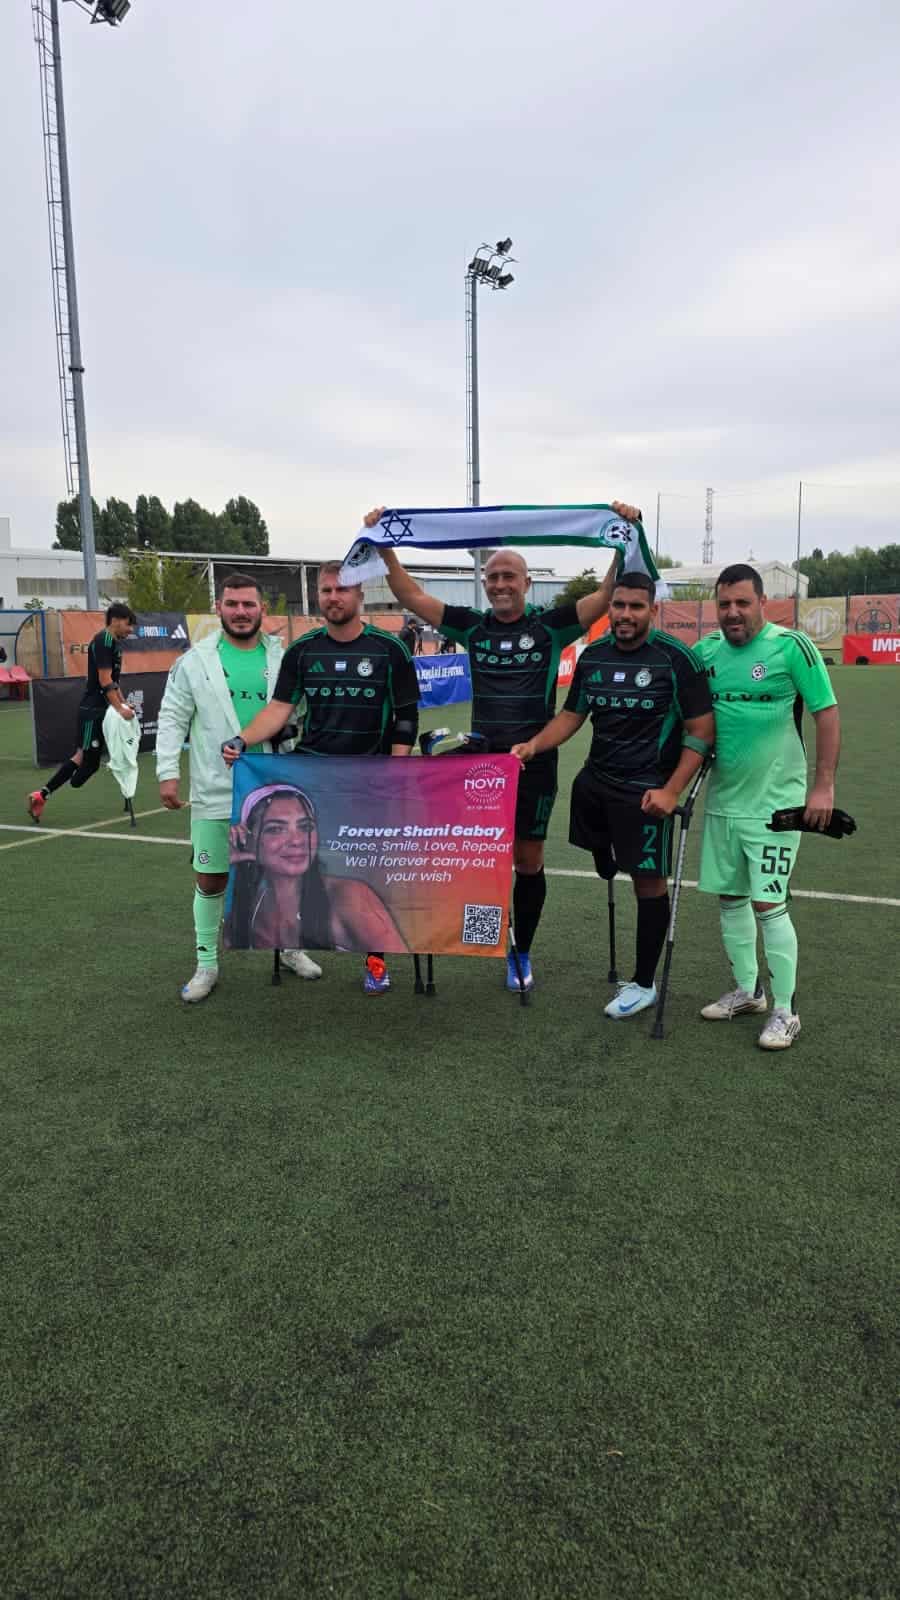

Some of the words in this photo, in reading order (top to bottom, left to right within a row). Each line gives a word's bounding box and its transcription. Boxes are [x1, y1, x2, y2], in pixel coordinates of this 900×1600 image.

[475, 652, 542, 665] VOLVO
[304, 687, 376, 698] VOLVO
[586, 694, 654, 709] VOLVO
[464, 777, 505, 791] NOVA
[338, 825, 403, 837] Forever
[403, 824, 450, 837] Shani
[451, 825, 504, 840] Gabay
[641, 825, 657, 853] 2
[424, 840, 459, 853] Love,
[345, 855, 376, 867] We'll
[378, 855, 428, 868] forever
[431, 857, 469, 870] carry
[472, 858, 496, 868] out
[760, 845, 792, 876] 55
[384, 872, 416, 885] your
[420, 871, 451, 882] wish
